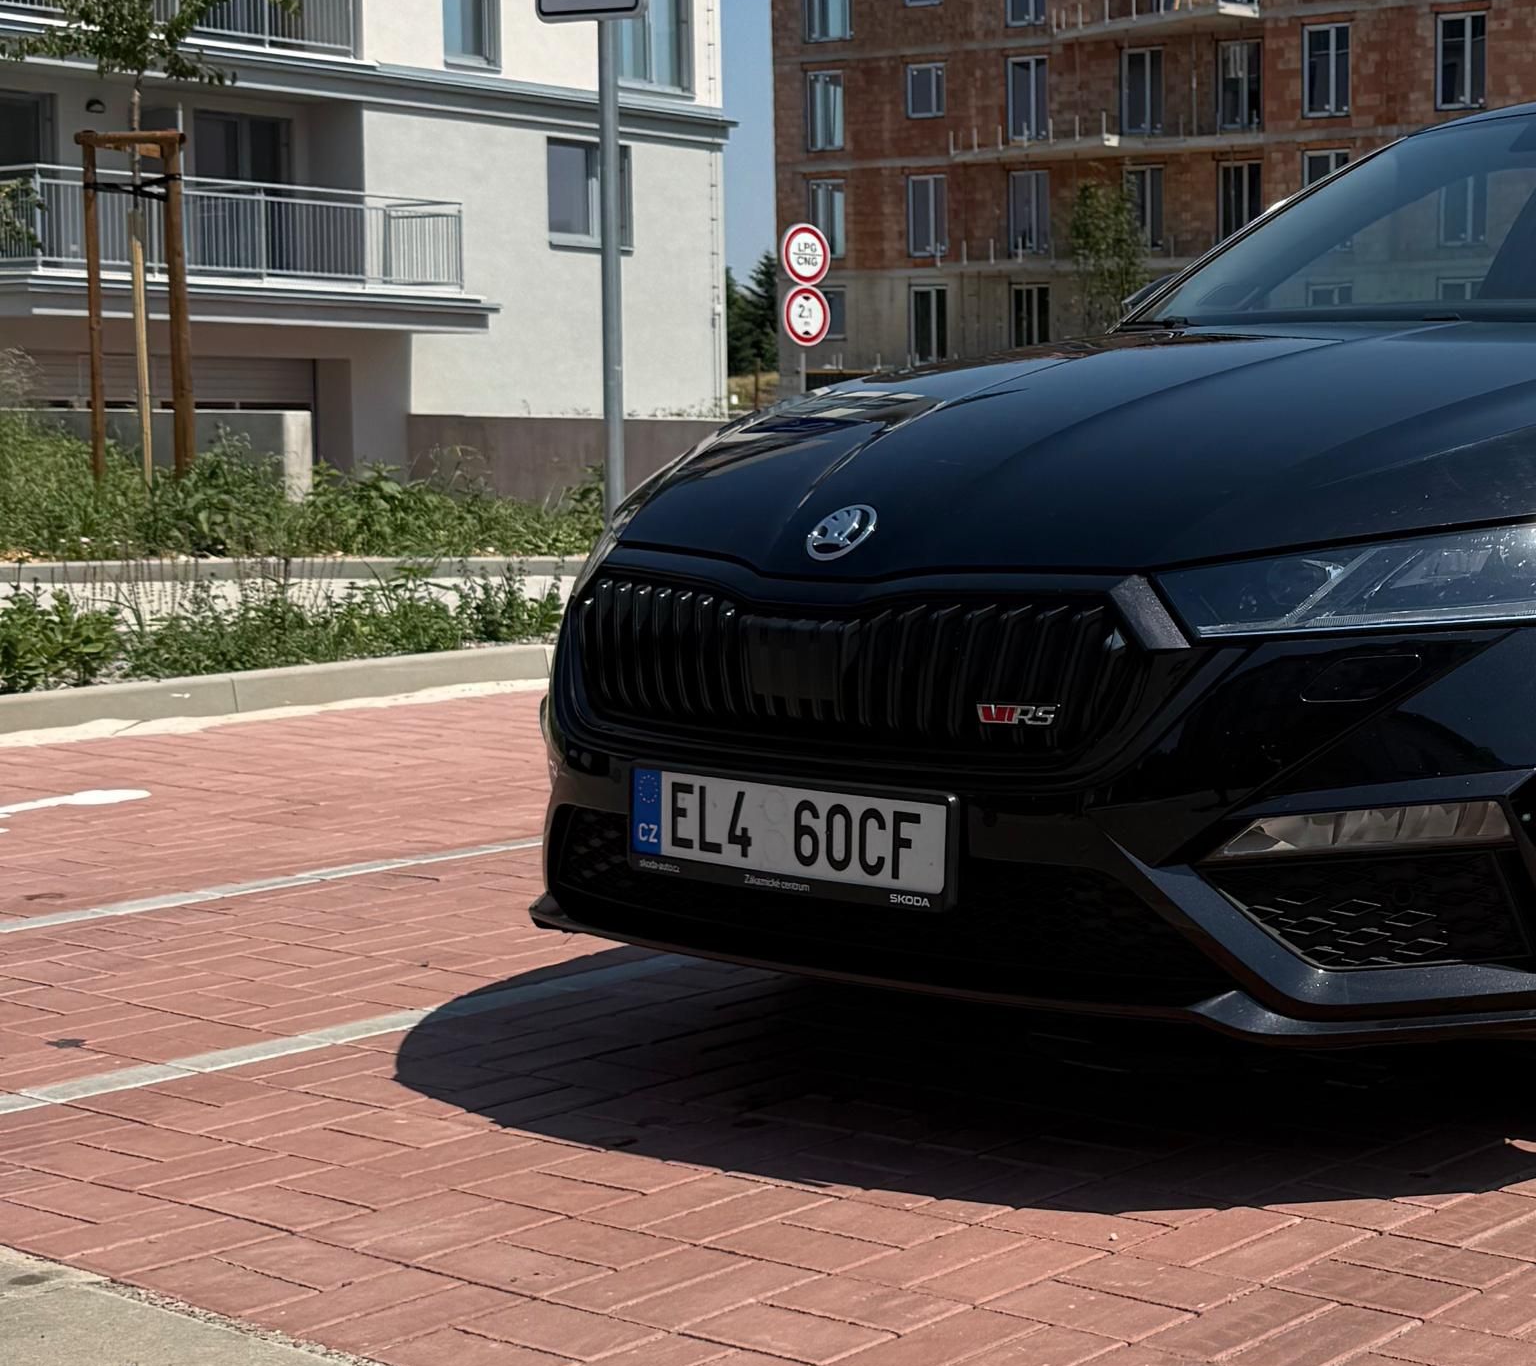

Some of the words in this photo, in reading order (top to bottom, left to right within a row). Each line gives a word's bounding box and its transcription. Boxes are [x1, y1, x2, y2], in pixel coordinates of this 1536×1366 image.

[798, 242, 817, 253] LPG
[797, 256, 818, 267] CNG
[638, 823, 659, 843] CZ
[671, 782, 752, 858] EL4
[794, 800, 921, 880] 60CF
